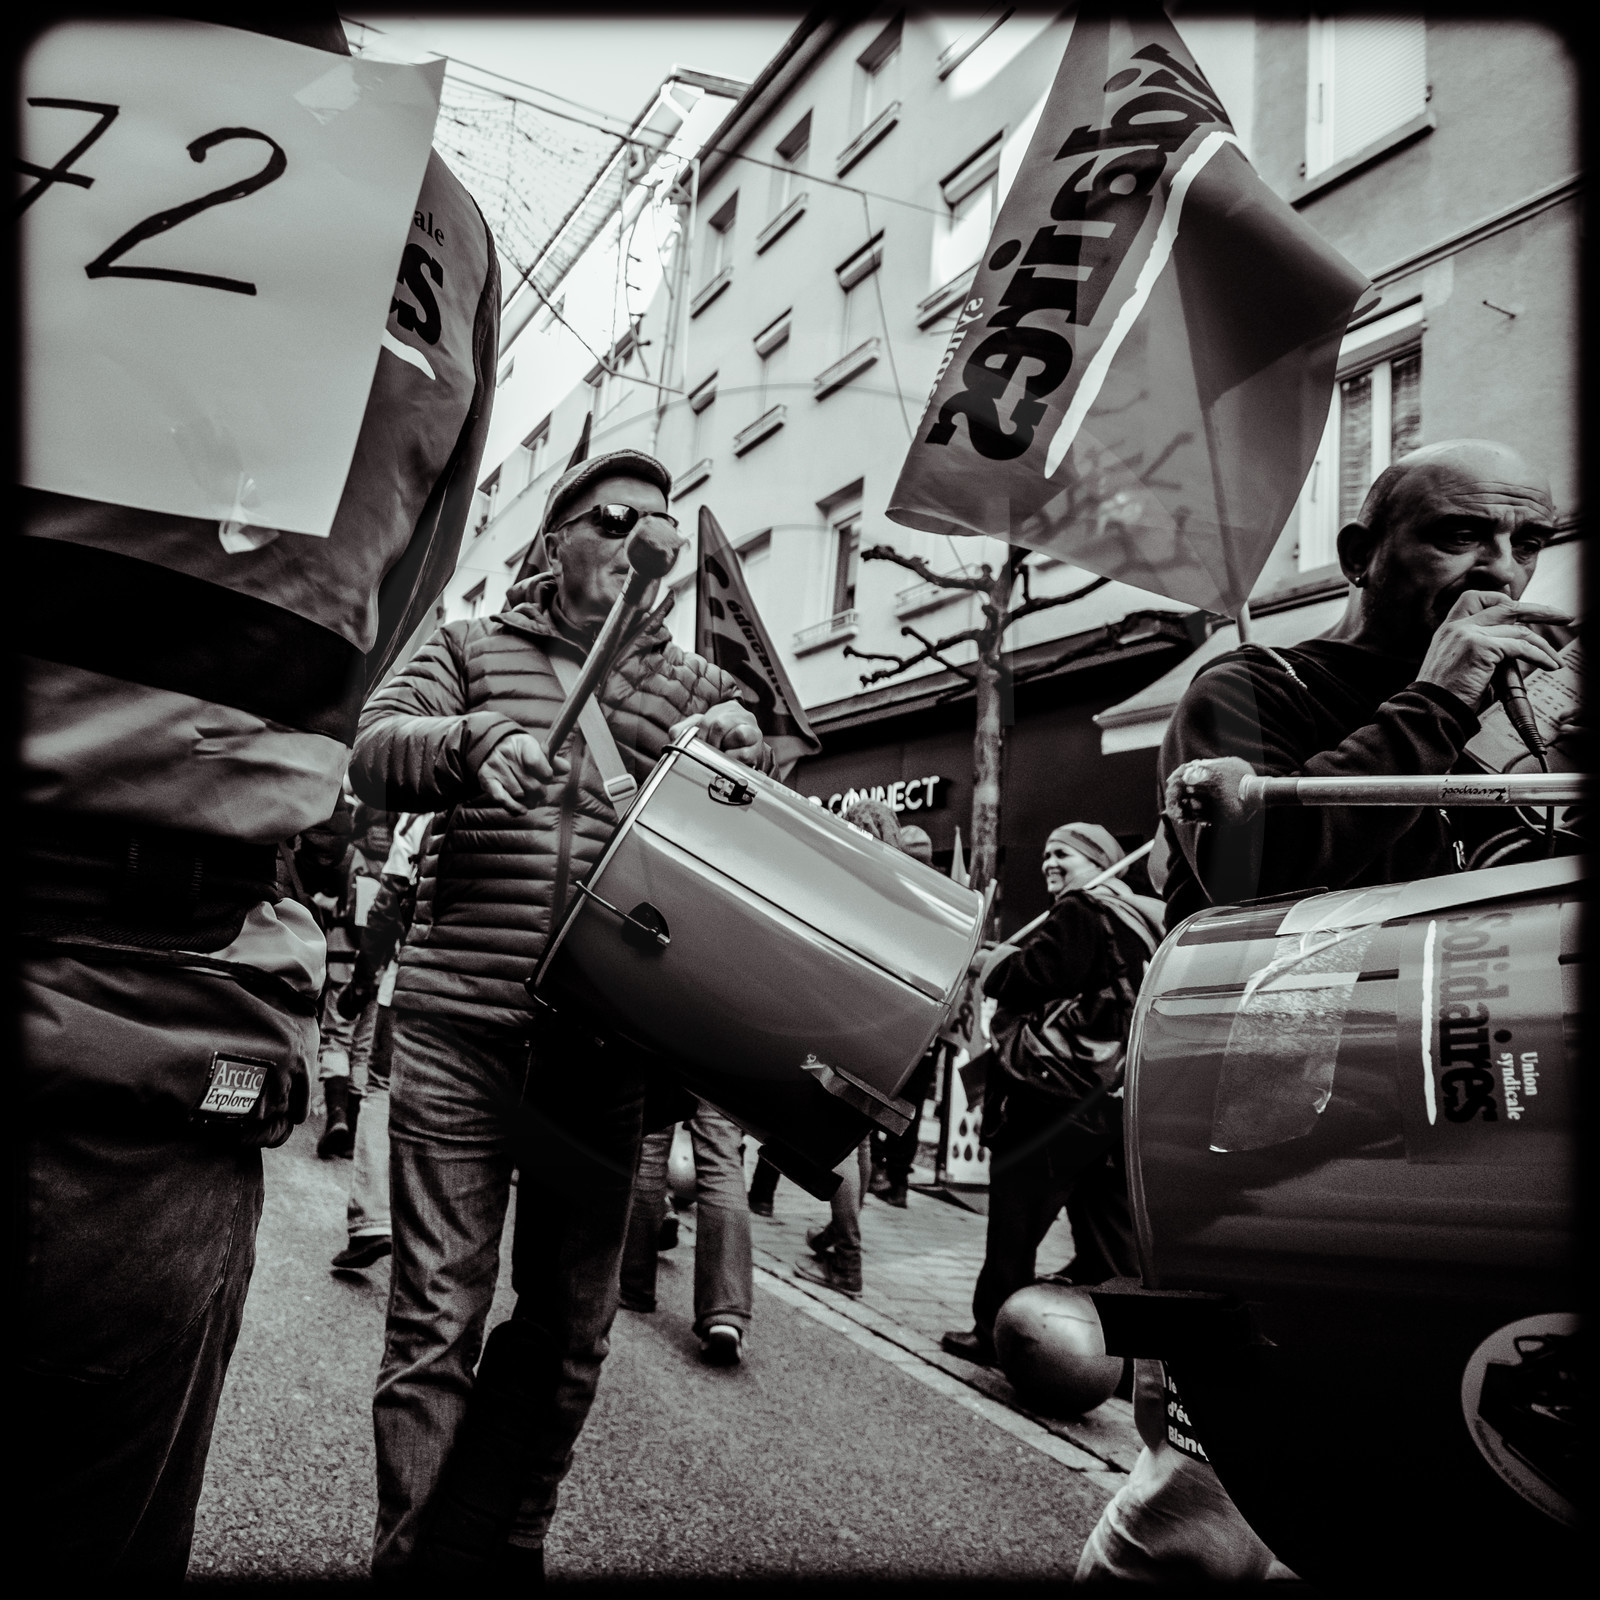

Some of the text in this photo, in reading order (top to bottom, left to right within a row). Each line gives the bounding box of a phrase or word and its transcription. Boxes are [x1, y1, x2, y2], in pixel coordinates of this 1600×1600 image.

[1442, 785, 1507, 802] Liverpool
[1439, 912, 1513, 1124] Solidaires
[213, 1062, 263, 1090] Arctic
[1497, 1052, 1525, 1121] syndicale
[1520, 1052, 1540, 1096] Union
[205, 1088, 257, 1110] Explorer
